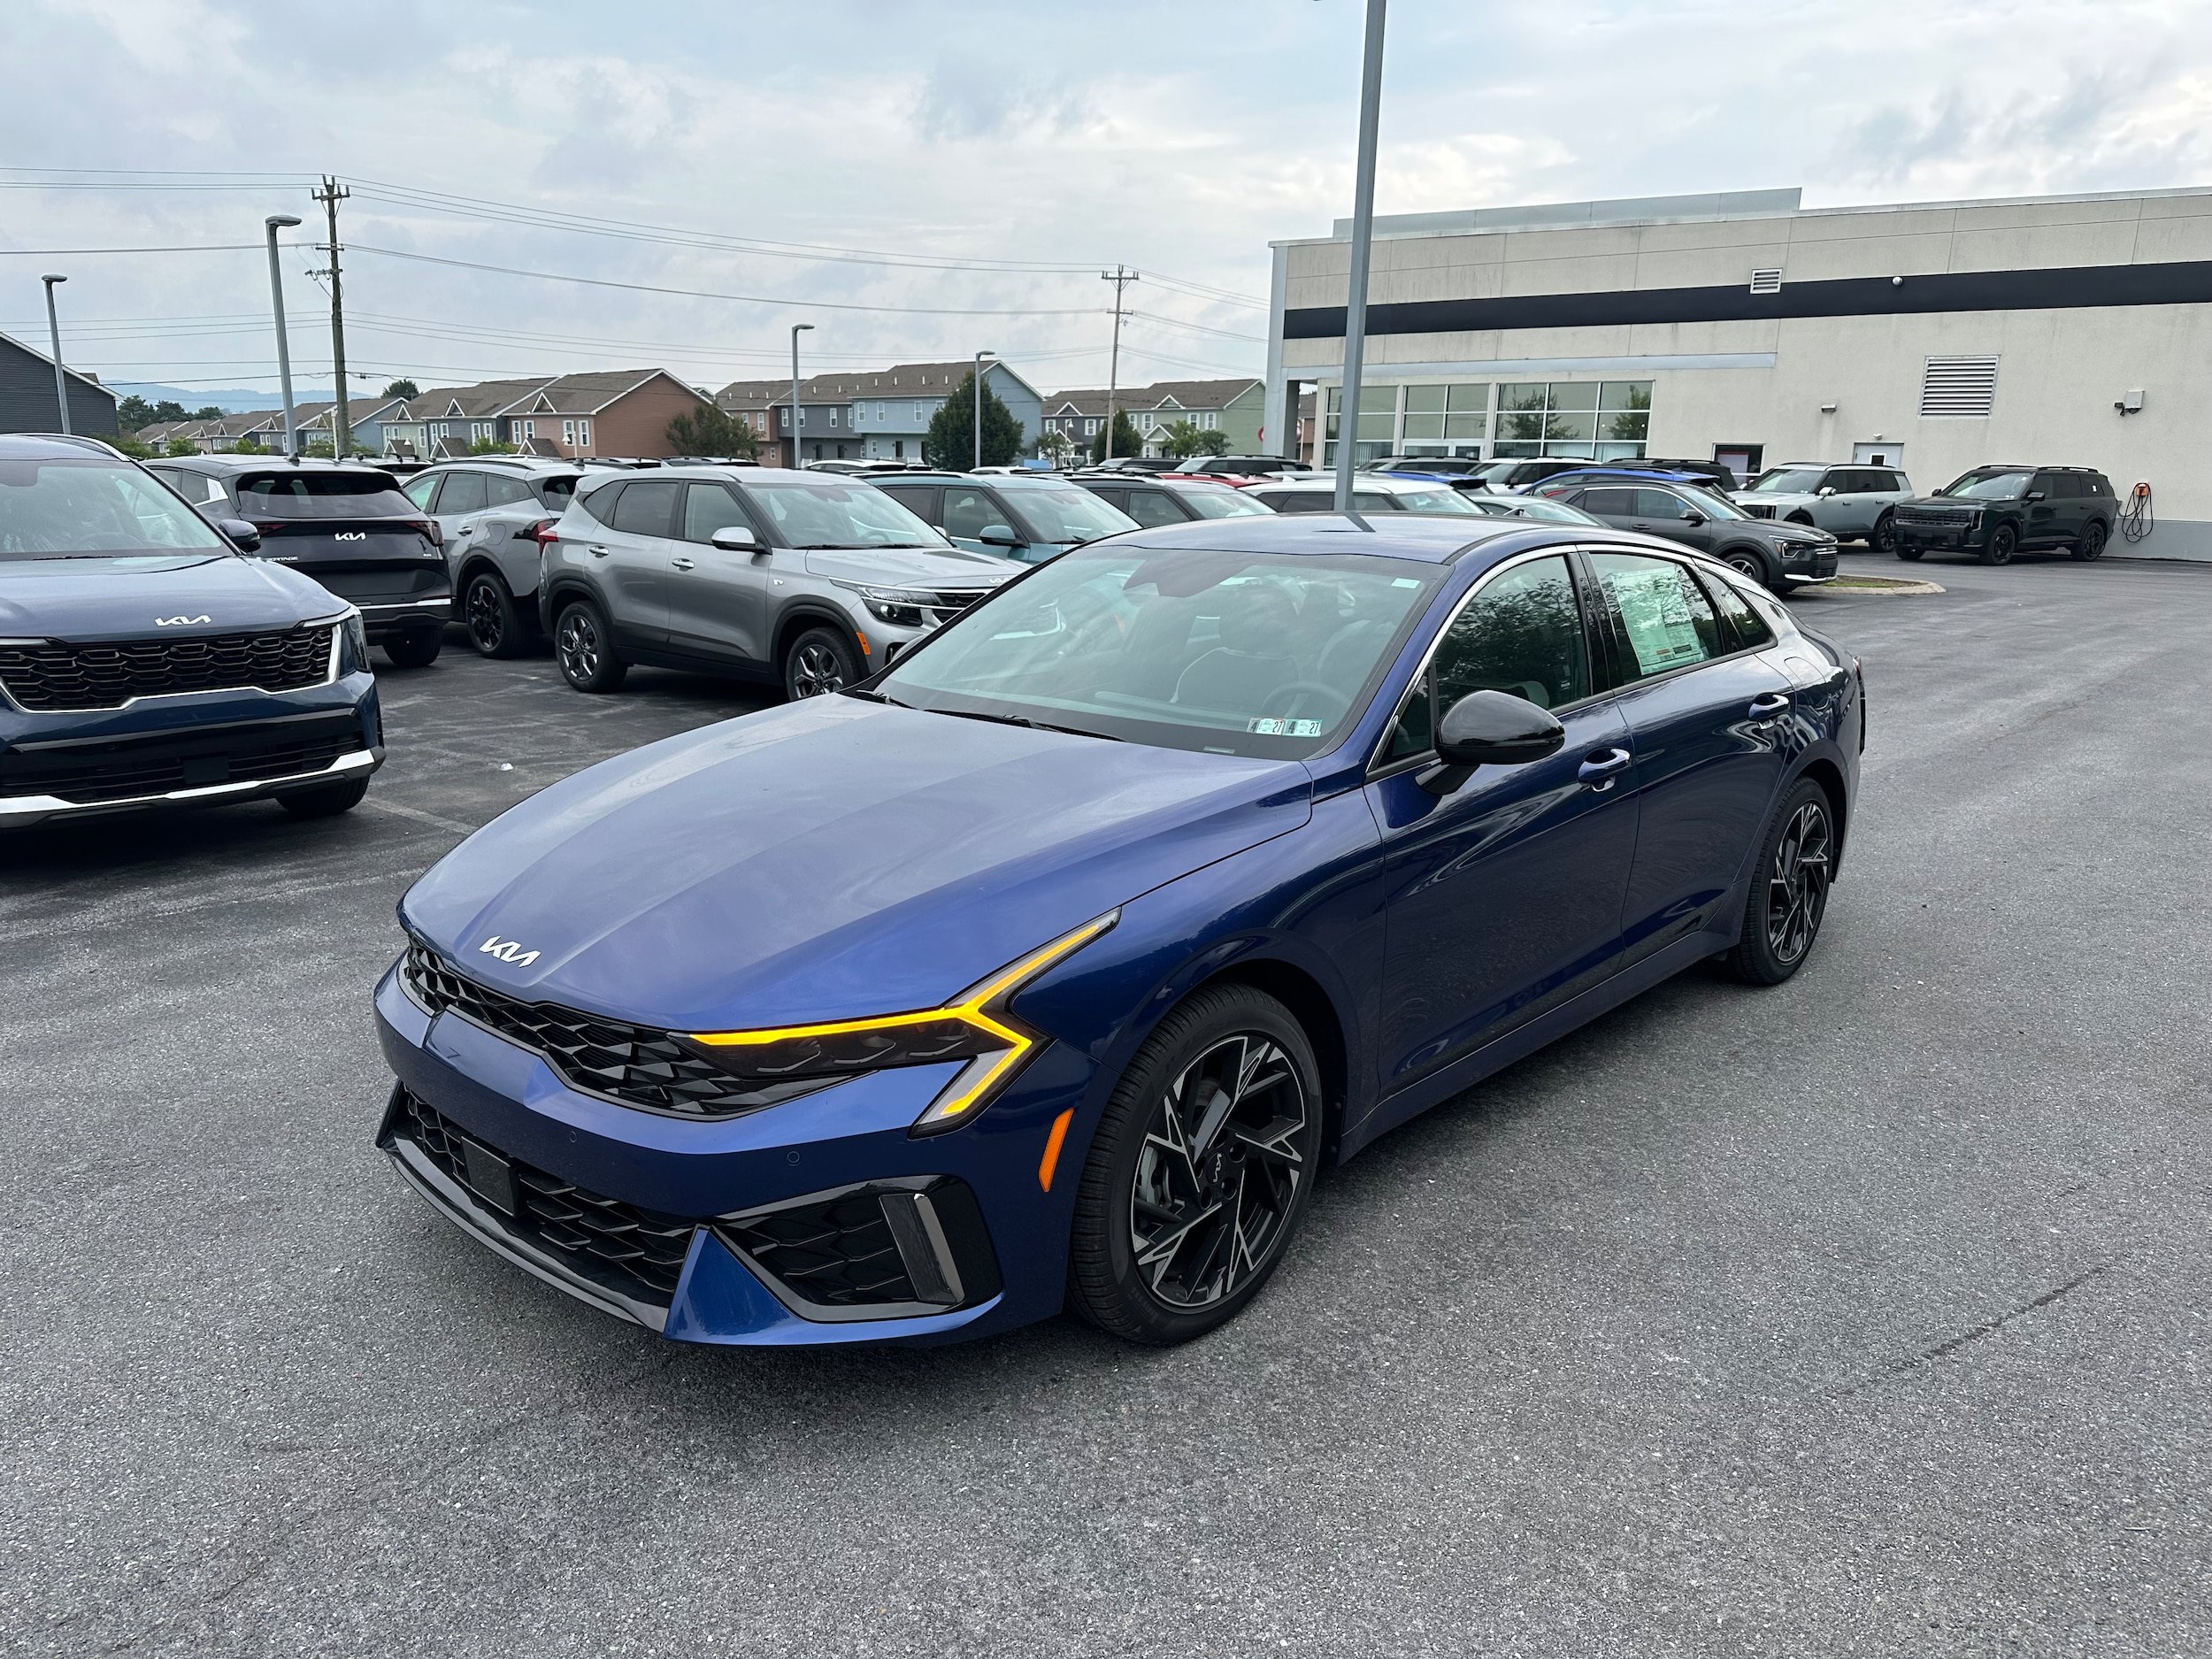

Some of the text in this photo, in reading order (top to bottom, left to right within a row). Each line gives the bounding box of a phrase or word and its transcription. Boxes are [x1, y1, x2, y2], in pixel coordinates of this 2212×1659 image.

[334, 532, 366, 541] KIA
[155, 614, 211, 626] KIA
[1250, 721, 1283, 733] 4 27
[1288, 721, 1319, 734] 4 27
[479, 935, 541, 969] KIA
